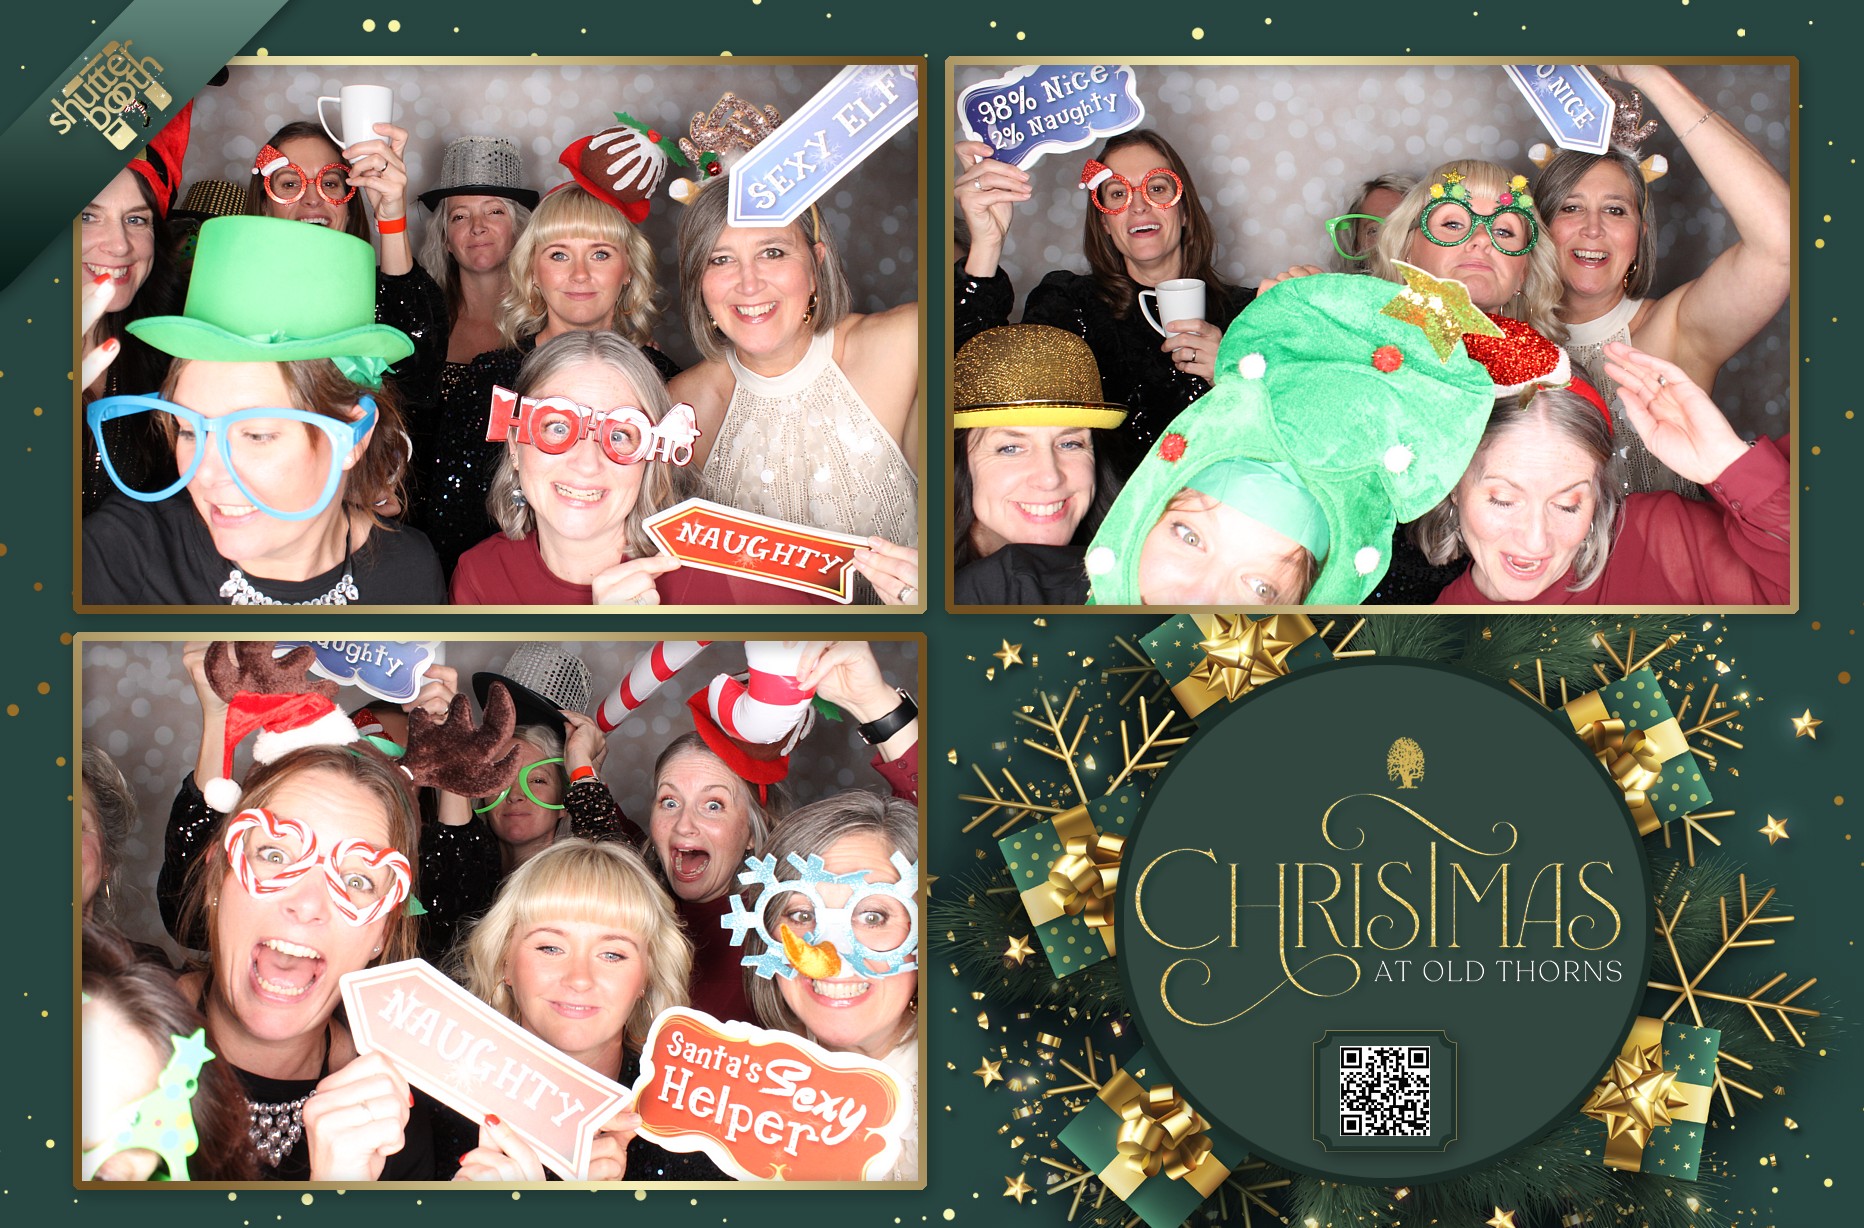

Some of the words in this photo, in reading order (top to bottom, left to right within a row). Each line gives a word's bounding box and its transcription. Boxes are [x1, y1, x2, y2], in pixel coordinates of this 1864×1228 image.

[747, 129, 832, 209] SEXY
[832, 69, 900, 138] ELF
[977, 84, 1037, 125] 98%
[991, 122, 1025, 150] 2%
[1027, 92, 1117, 137] Naughty
[1547, 76, 1596, 130] NICE
[676, 520, 845, 577] NAUGHTY
[378, 988, 587, 1128] NAUGHTY
[666, 1030, 764, 1084] Santa's
[758, 1058, 867, 1146] Sexy
[657, 1064, 820, 1157] Helper
